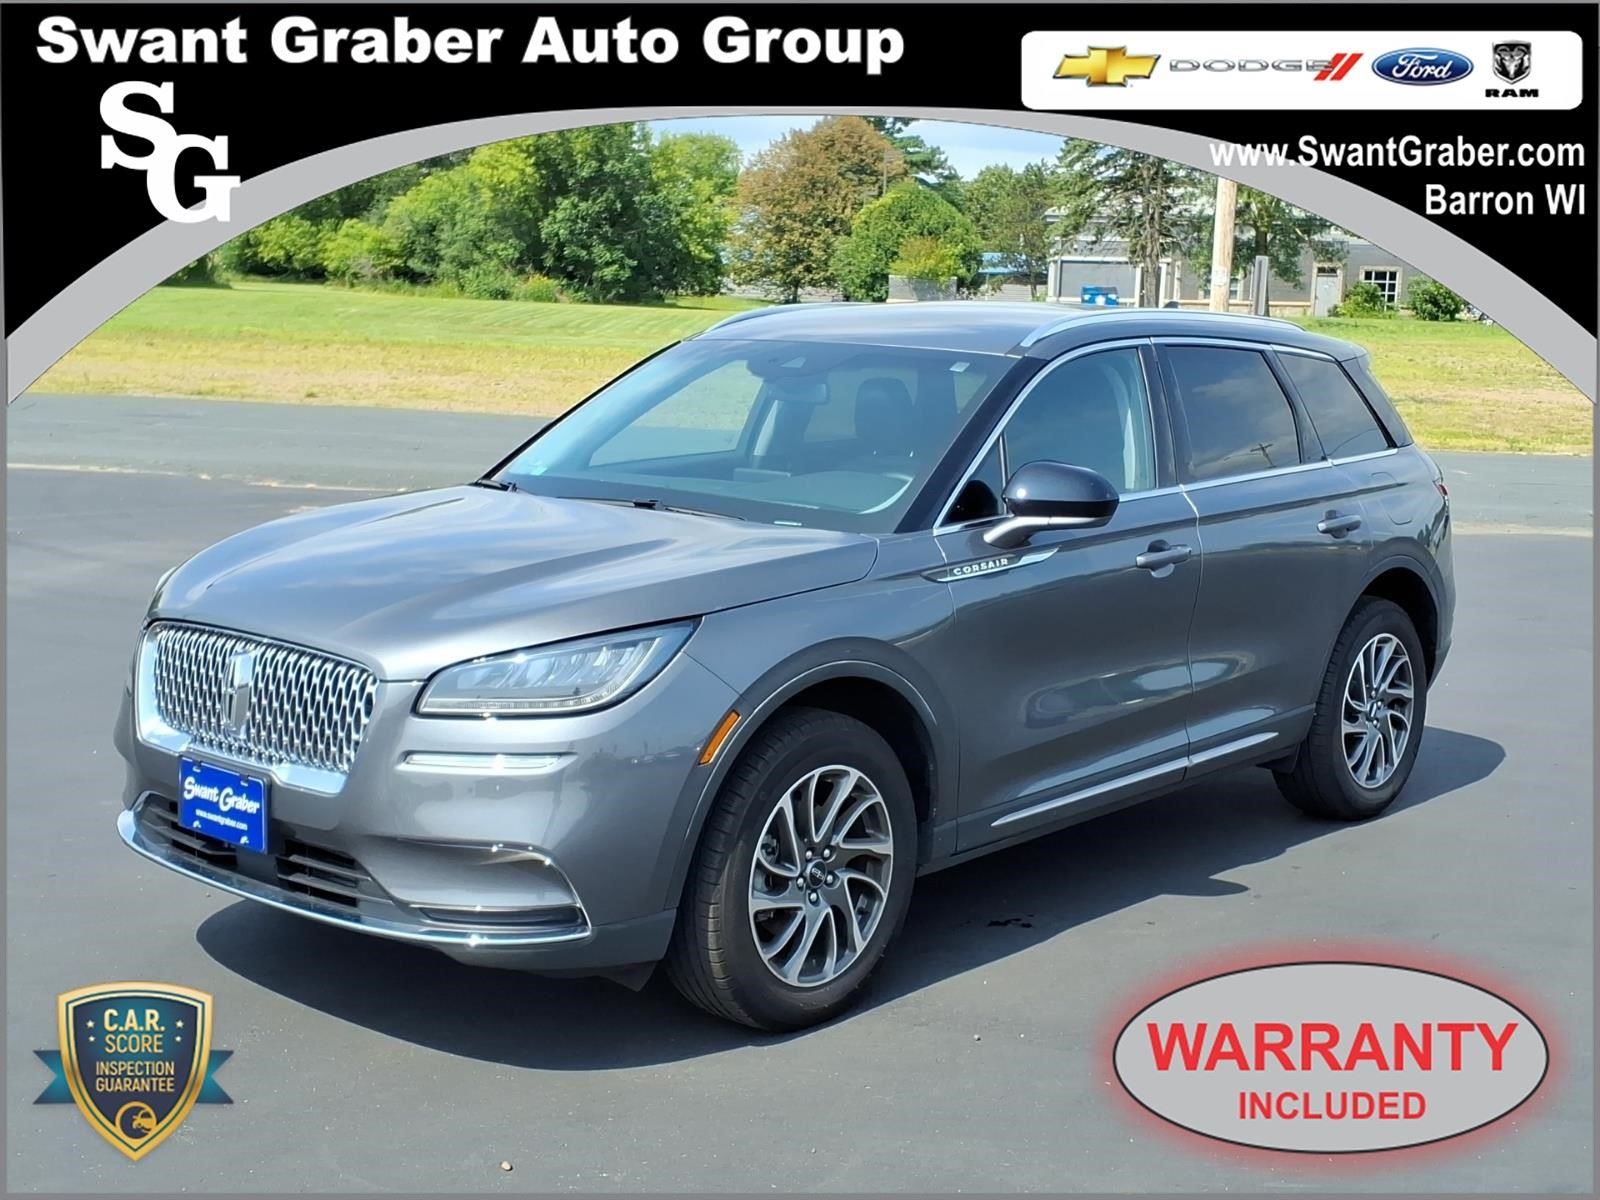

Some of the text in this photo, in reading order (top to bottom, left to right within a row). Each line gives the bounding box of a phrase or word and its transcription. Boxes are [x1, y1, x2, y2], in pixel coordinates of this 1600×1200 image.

[953, 558, 1009, 576] CORSAIR
[183, 776, 260, 814] Swant Graber
